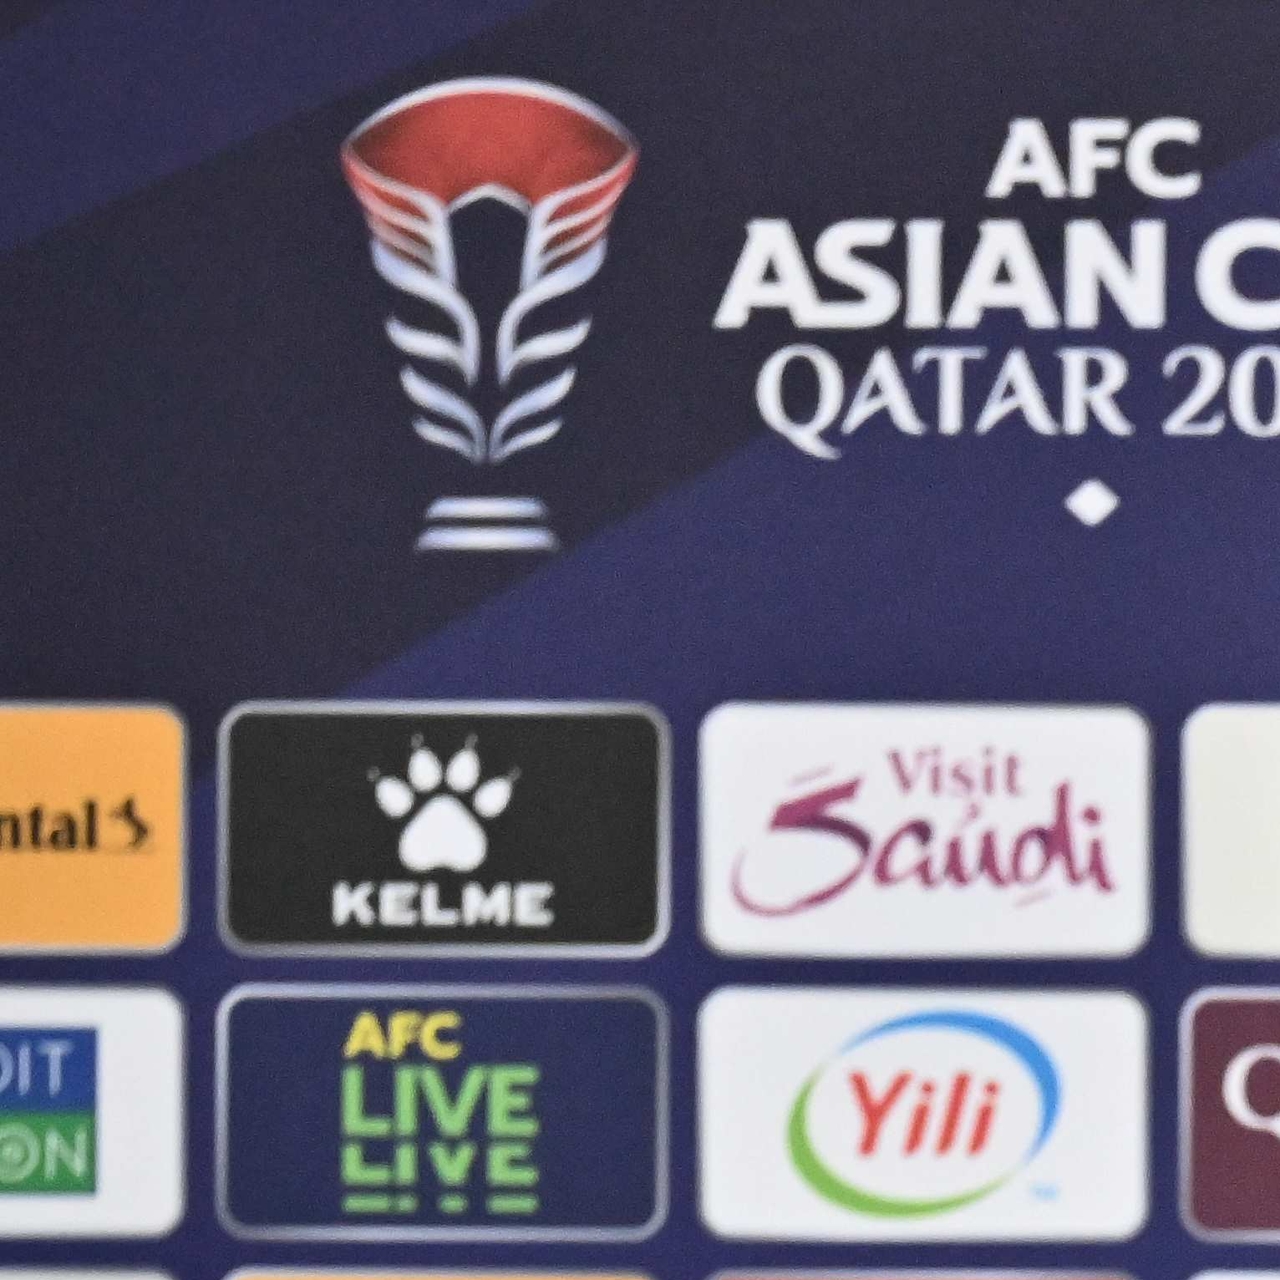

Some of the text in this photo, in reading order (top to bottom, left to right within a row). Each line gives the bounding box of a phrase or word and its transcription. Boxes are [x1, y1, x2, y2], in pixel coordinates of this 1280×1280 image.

[987, 118, 1200, 199] AFC
[714, 219, 1165, 329] ASIAN
[756, 345, 1132, 458] QATAR
[888, 748, 1019, 796] Visit
[733, 778, 1115, 917] Saudi
[333, 883, 552, 926] KELME
[345, 1012, 459, 1059] AFC
[343, 1066, 537, 1137] LIVE
[850, 1072, 998, 1156] Yili
